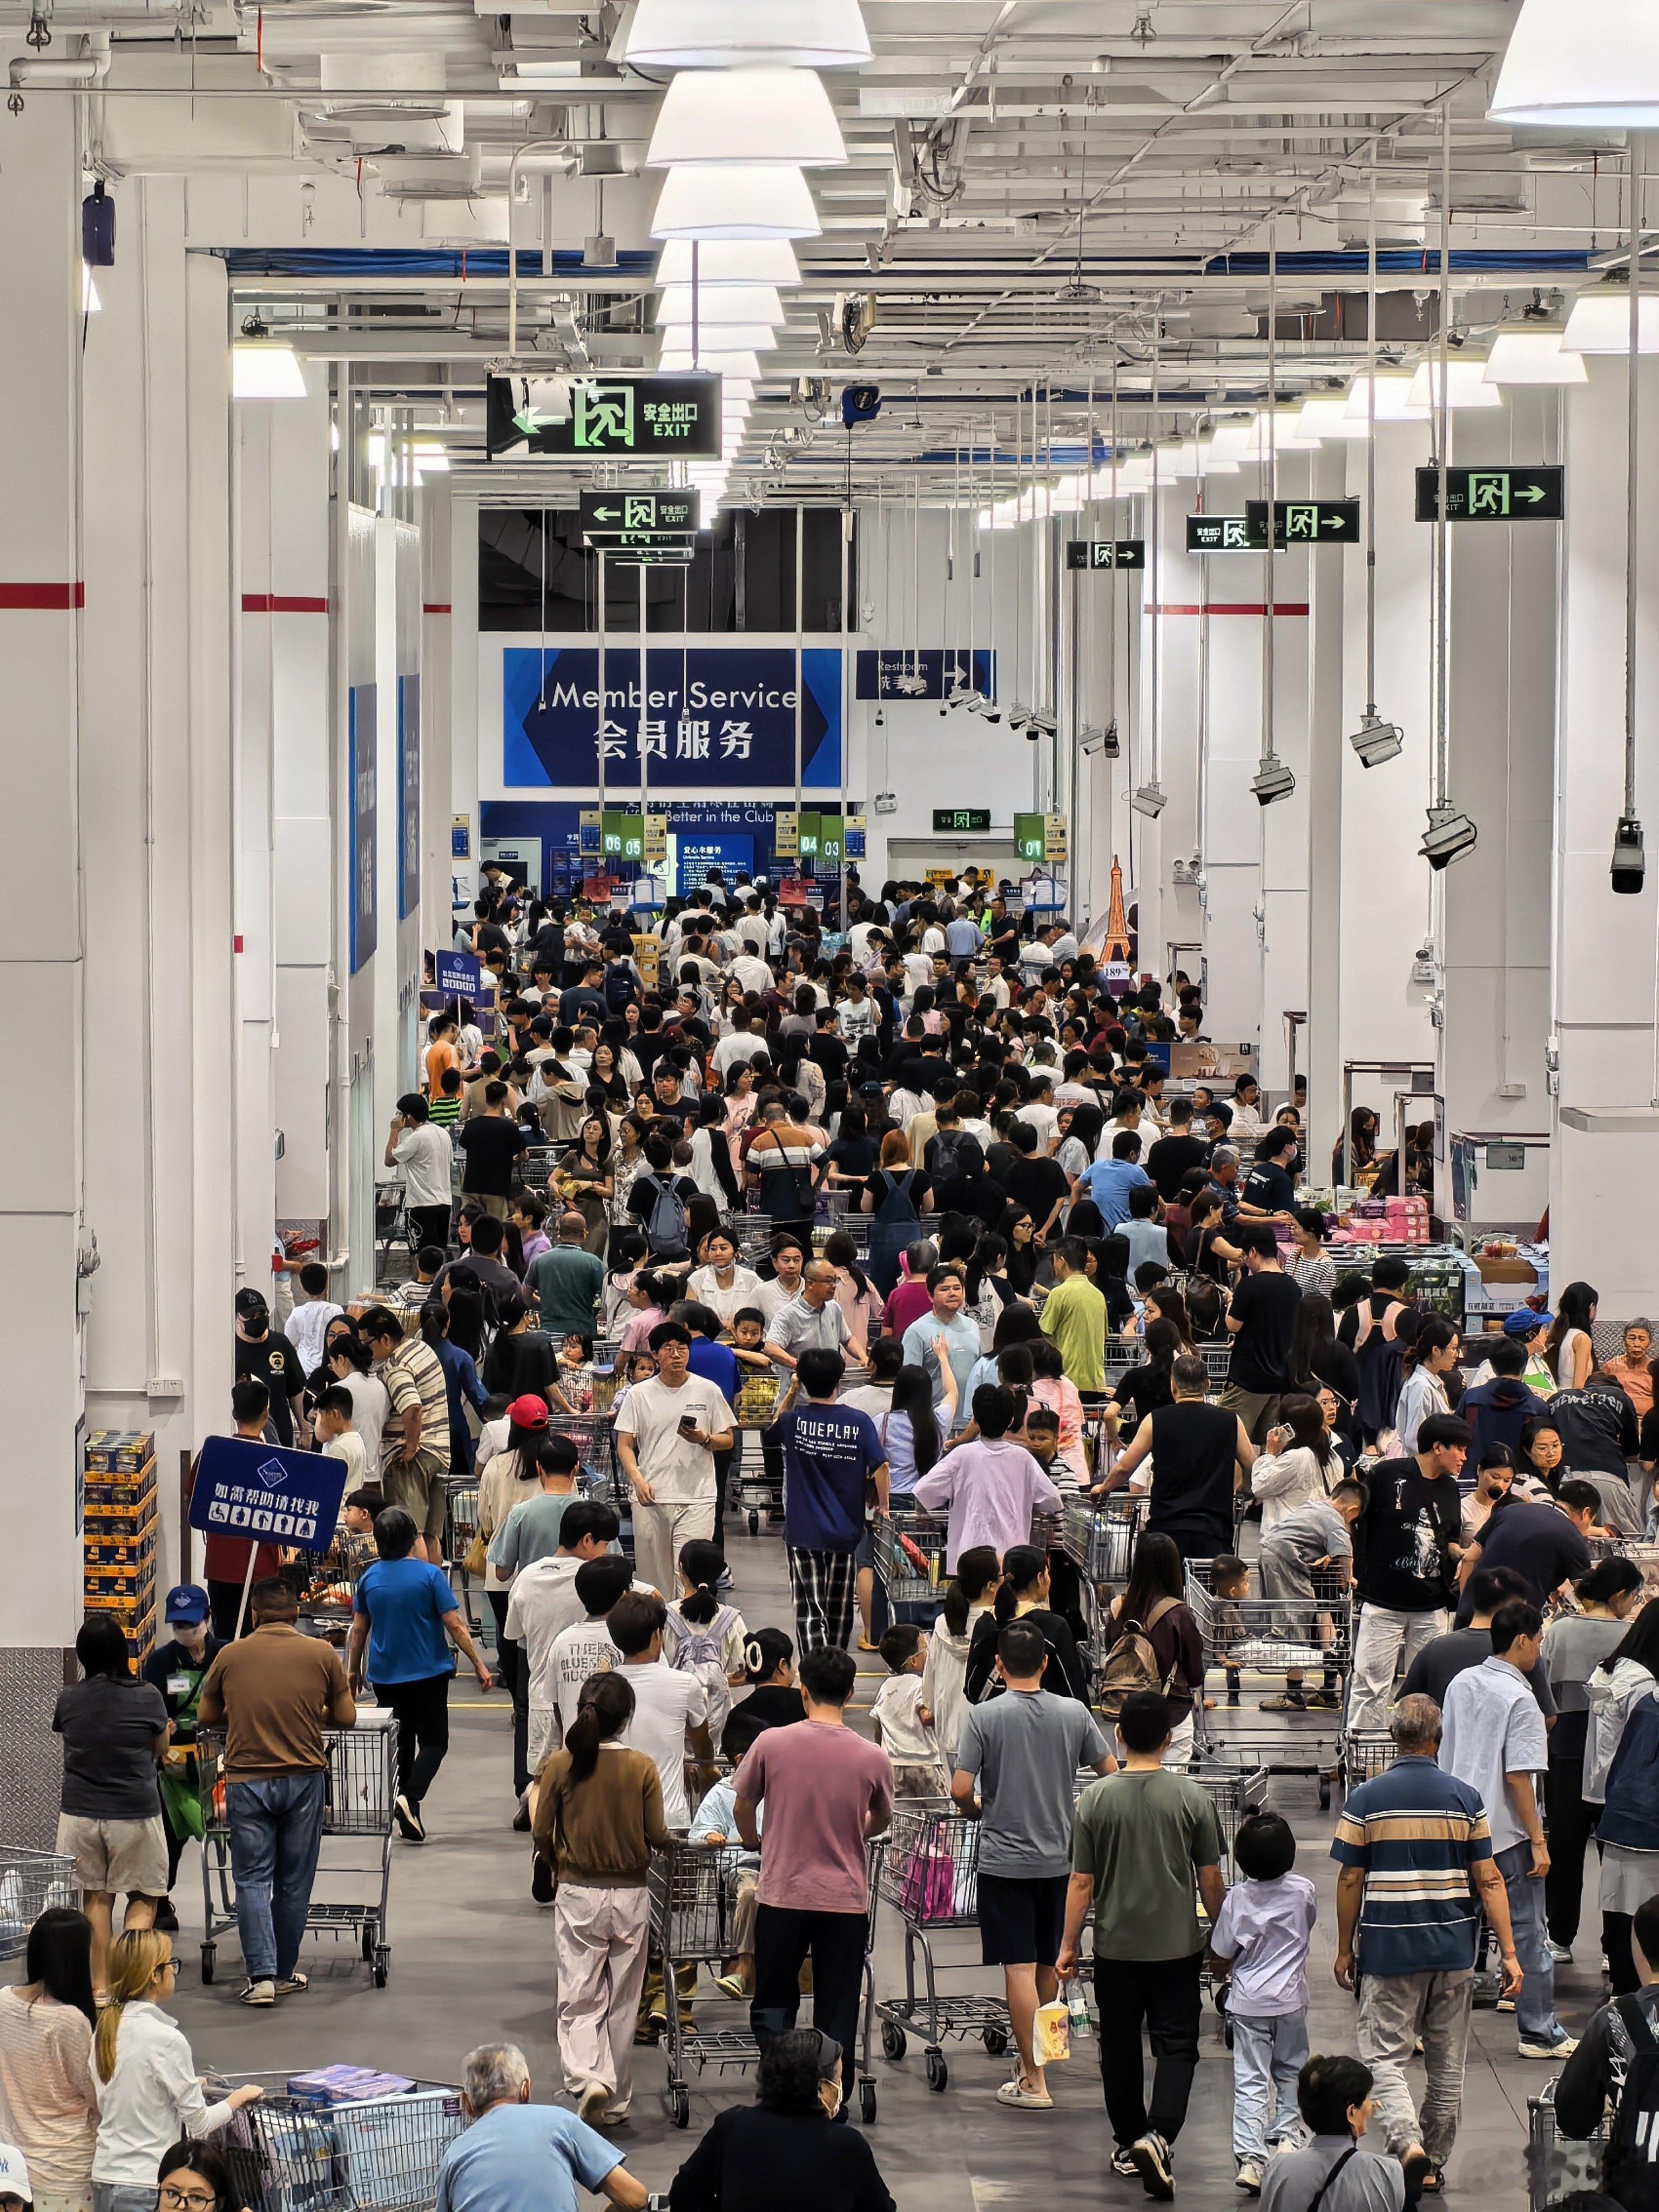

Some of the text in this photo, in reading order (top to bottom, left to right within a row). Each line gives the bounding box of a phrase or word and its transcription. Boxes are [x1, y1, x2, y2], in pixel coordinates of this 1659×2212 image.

[644, 403, 697, 421] 安全出口
[654, 424, 690, 436] EXIT
[660, 505, 688, 514] 安全出口
[552, 681, 798, 709] Member Service
[593, 720, 753, 759] 会员服务
[665, 810, 702, 822] Better
[706, 810, 716, 822] in
[721, 811, 740, 822] the
[745, 810, 773, 822] Club
[606, 836, 621, 850] 06
[626, 840, 640, 855] 05
[802, 837, 817, 851] 04
[825, 841, 839, 856] 03
[1026, 839, 1041, 856] 01
[1105, 968, 1121, 977] 189
[215, 1482, 320, 1516] 如需帮助请找我
